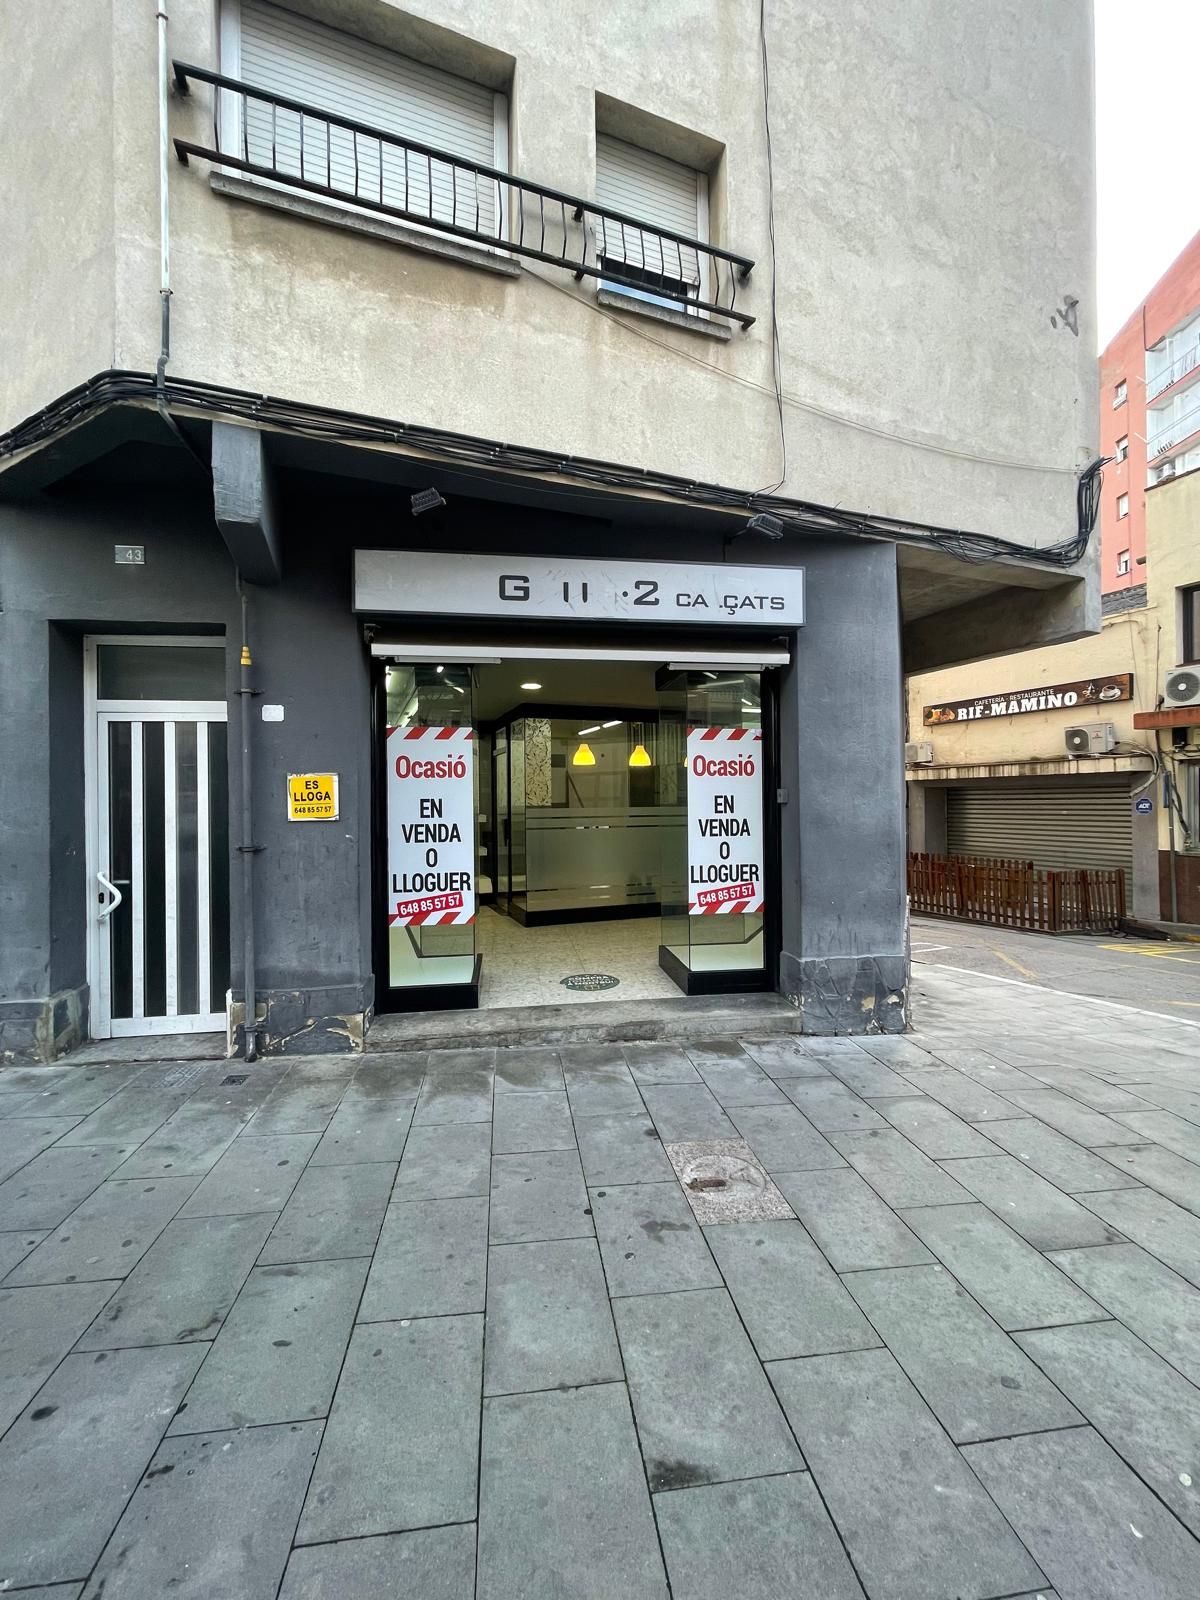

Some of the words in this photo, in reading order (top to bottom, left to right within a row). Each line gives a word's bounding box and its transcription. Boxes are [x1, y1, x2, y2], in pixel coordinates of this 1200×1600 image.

[126, 549, 142, 560] 43
[957, 691, 1078, 720] RIF-MAMINO
[974, 696, 1005, 706] CAFETERÍA
[1009, 689, 1054, 700] RESTAURANTE
[395, 754, 467, 779] Ocasió
[692, 754, 756, 777] Ocasió
[305, 780, 319, 790] ES
[293, 791, 331, 802] LLOGA
[714, 795, 735, 814] EN
[294, 806, 306, 814] 648
[419, 798, 443, 819] EN
[402, 823, 462, 843] VENDA
[698, 818, 751, 837] VENDA
[425, 848, 438, 868] O
[719, 841, 731, 860] O
[392, 872, 471, 893] LLOGUER
[690, 864, 760, 883] LLOGUER
[700, 892, 717, 905] 648
[717, 890, 729, 901] 85
[729, 887, 741, 899] 57
[741, 884, 753, 896] 57
[400, 902, 420, 916] 648
[420, 899, 434, 912] 85
[434, 896, 447, 909] 57
[448, 894, 460, 906] 57
